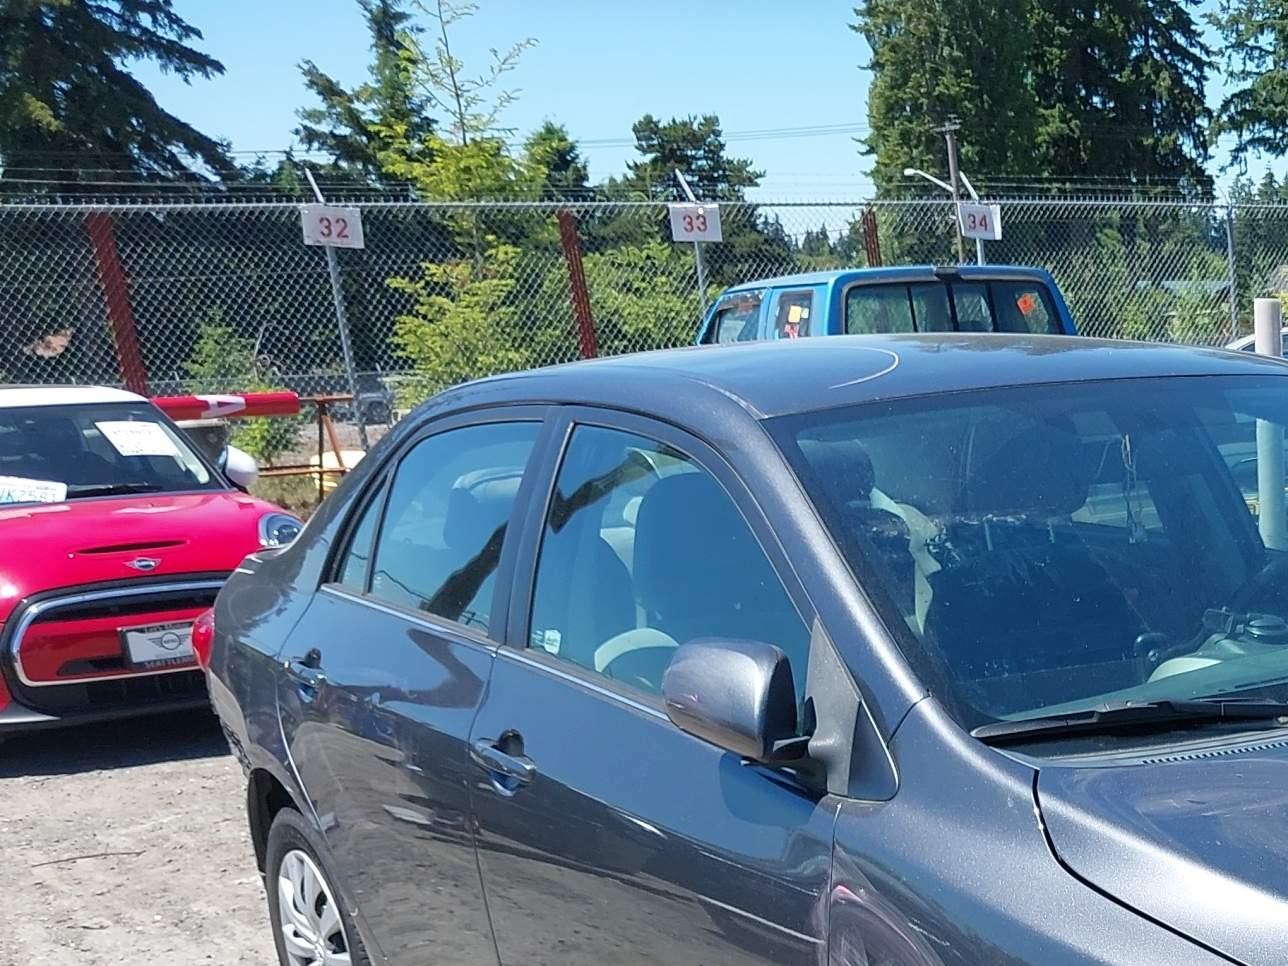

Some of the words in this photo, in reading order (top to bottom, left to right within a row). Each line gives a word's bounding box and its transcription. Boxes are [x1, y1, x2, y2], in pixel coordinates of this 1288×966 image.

[319, 216, 350, 239] 32
[682, 214, 707, 233] 33
[967, 213, 988, 232] 34
